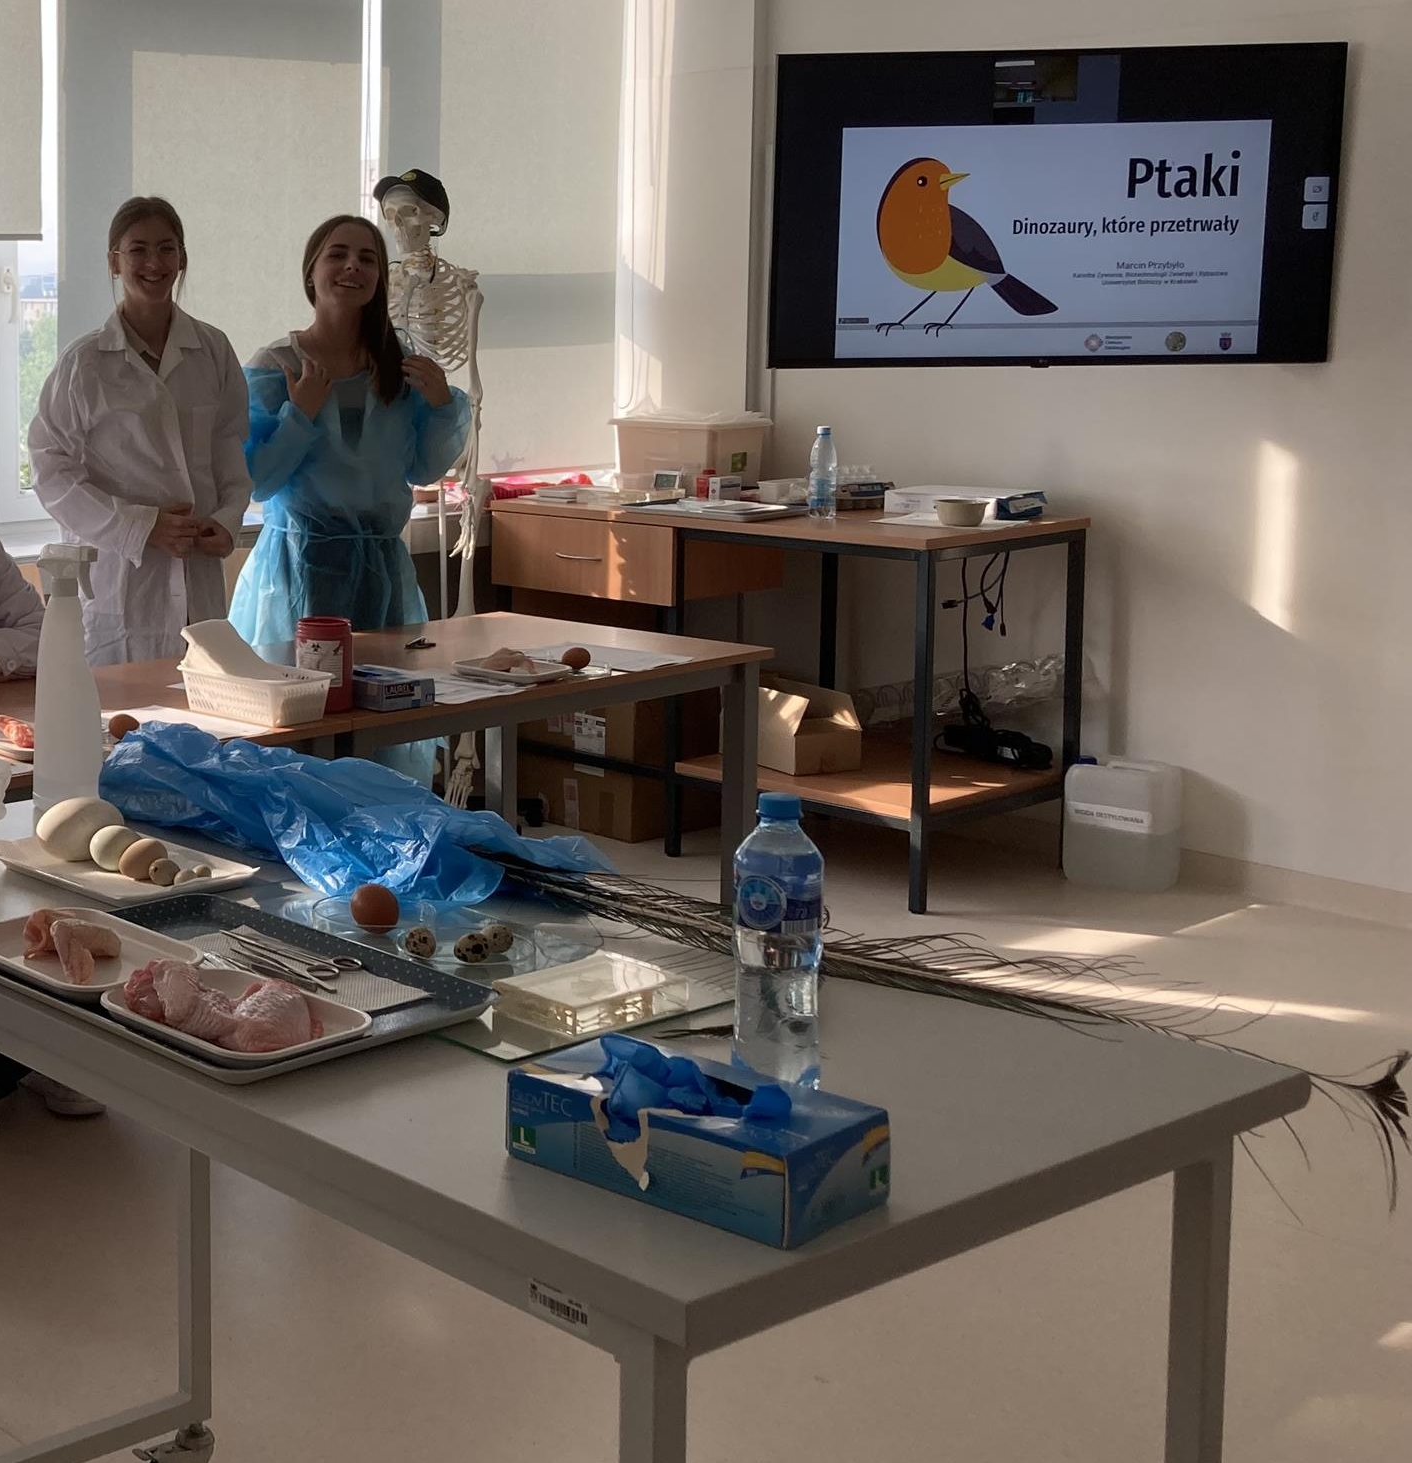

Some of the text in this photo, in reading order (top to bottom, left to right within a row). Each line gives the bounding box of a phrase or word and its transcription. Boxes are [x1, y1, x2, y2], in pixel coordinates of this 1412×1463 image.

[1127, 149, 1241, 200] Ptaki
[1012, 213, 1239, 238] Dinozaury, które przetrwały
[1116, 261, 1146, 269] Marcin
[520, 1126, 531, 1146] L
